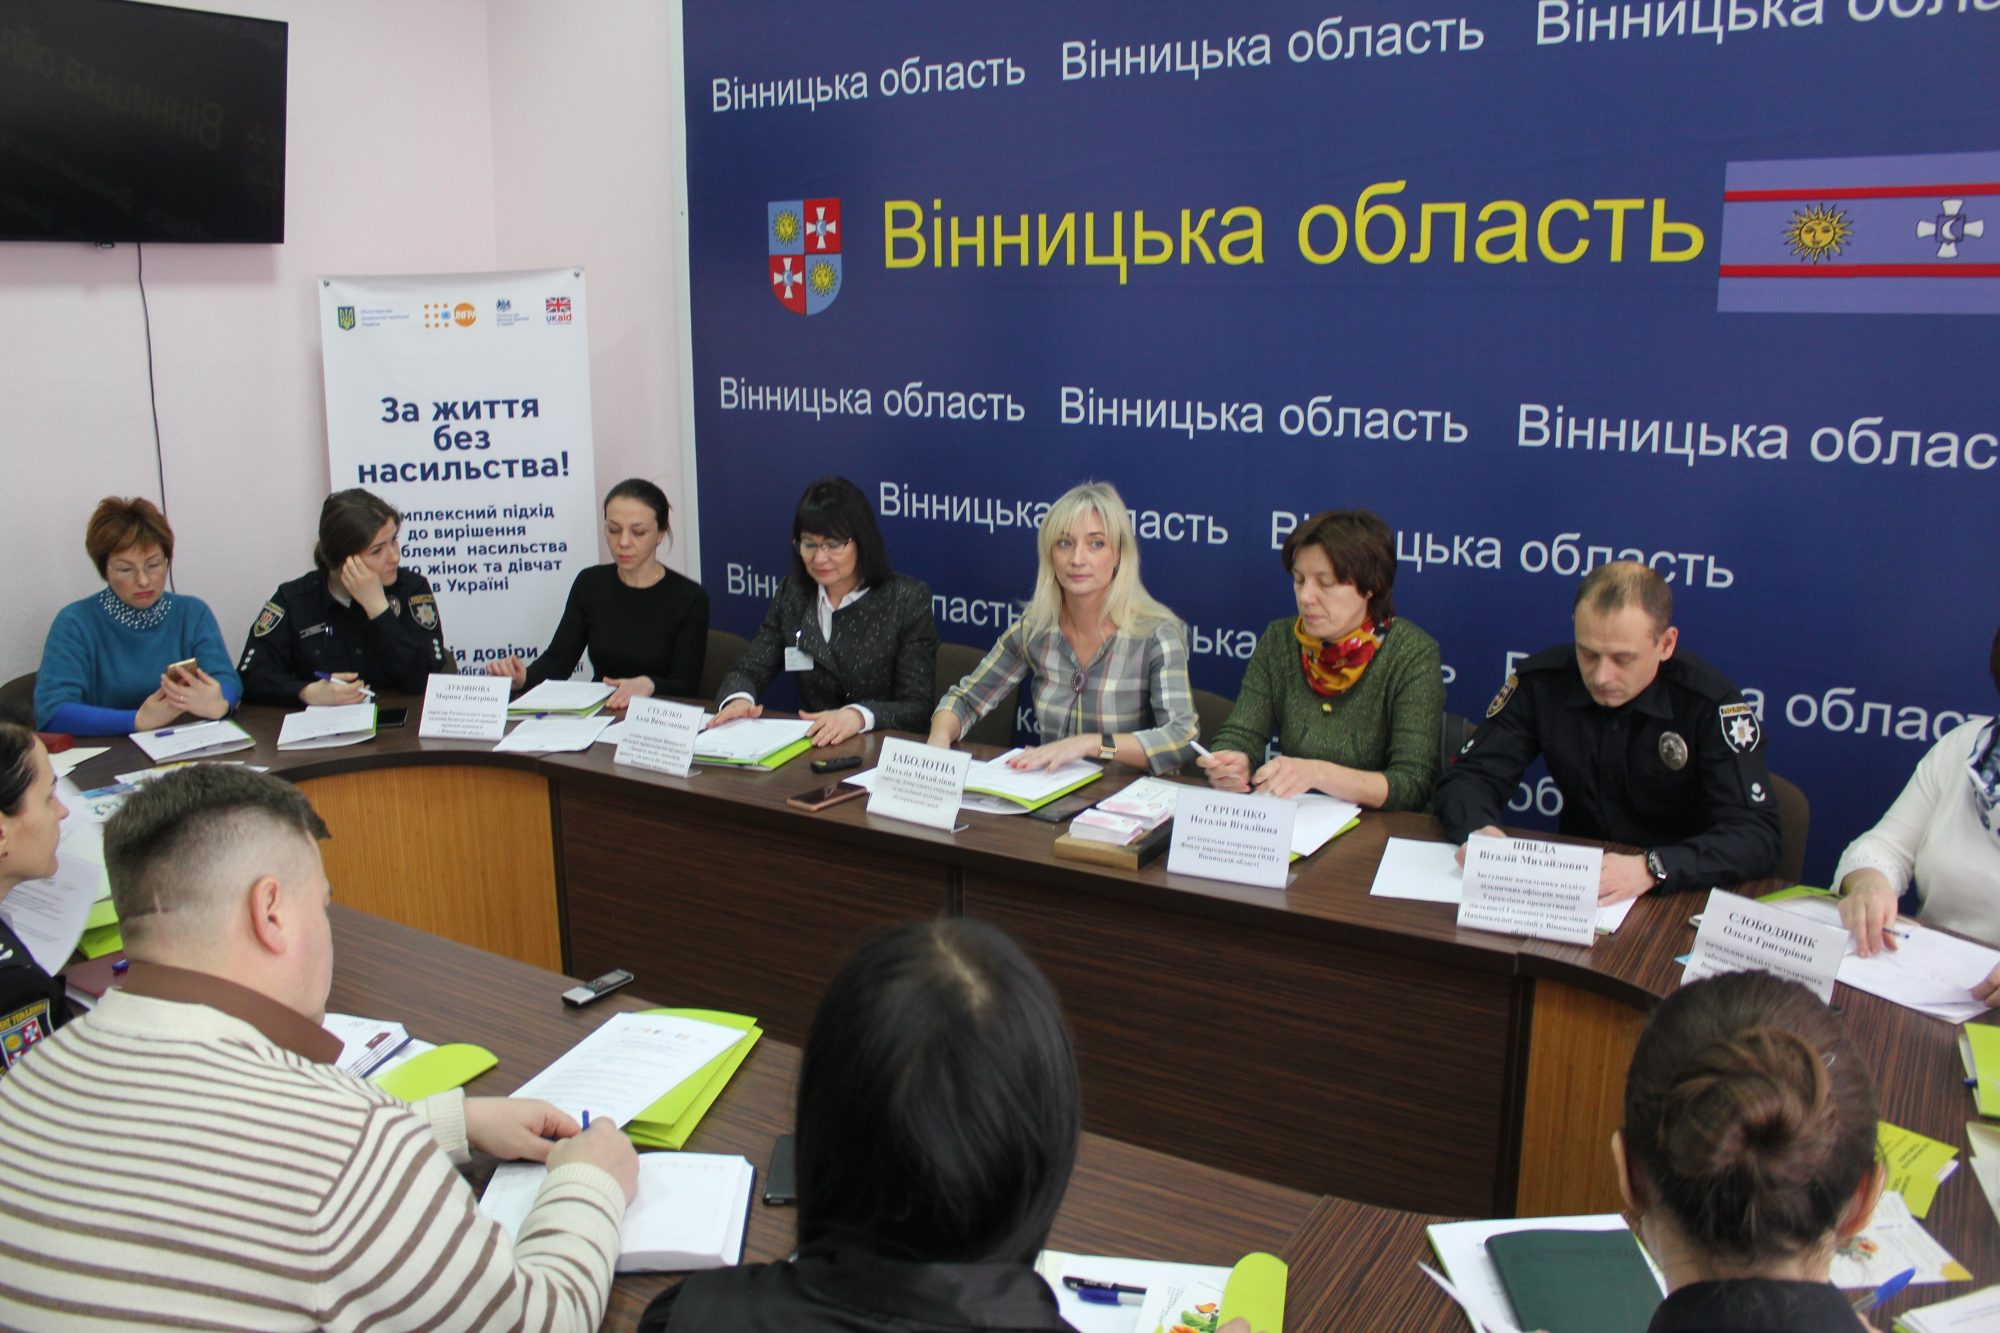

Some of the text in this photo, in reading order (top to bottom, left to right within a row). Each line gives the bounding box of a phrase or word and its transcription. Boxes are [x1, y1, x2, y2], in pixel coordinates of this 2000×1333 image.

[1536, 0, 1823, 45] Вінницька
[1062, 16, 1485, 81] Вінницька область
[712, 56, 1026, 112] Вінницька область
[884, 180, 1705, 285] Вінницька область
[380, 397, 540, 423] За життя
[720, 377, 1026, 422] Вінницька область
[1061, 386, 1469, 443] Вінницька область
[433, 424, 491, 451] без
[1517, 403, 1789, 467] Вінницька
[358, 451, 569, 484] насильства!
[400, 503, 555, 525] мплексний підхід
[1129, 508, 1229, 544] асть
[408, 522, 526, 542] до вирішення
[401, 539, 568, 559] блеми насильства
[1520, 532, 1735, 589] облсть
[427, 558, 478, 576] жінок
[484, 563, 502, 574] та
[508, 556, 562, 574] дівчат
[432, 576, 509, 595] в Україні
[932, 594, 1024, 628] ласть
[1786, 687, 1994, 742] облас
[890, 751, 956, 776] ЗАБОЛОТНА
[1190, 814, 1227, 828] Наталія
[1204, 803, 1267, 820] СЕРГІЄНКО
[1479, 850, 1589, 872] Віталій Михайлович
[1513, 840, 1556, 854] ШВЕДА
[1723, 925, 1813, 963] Ольга Григорівна
[1728, 911, 1819, 949] СЛОБОДЯНИК
